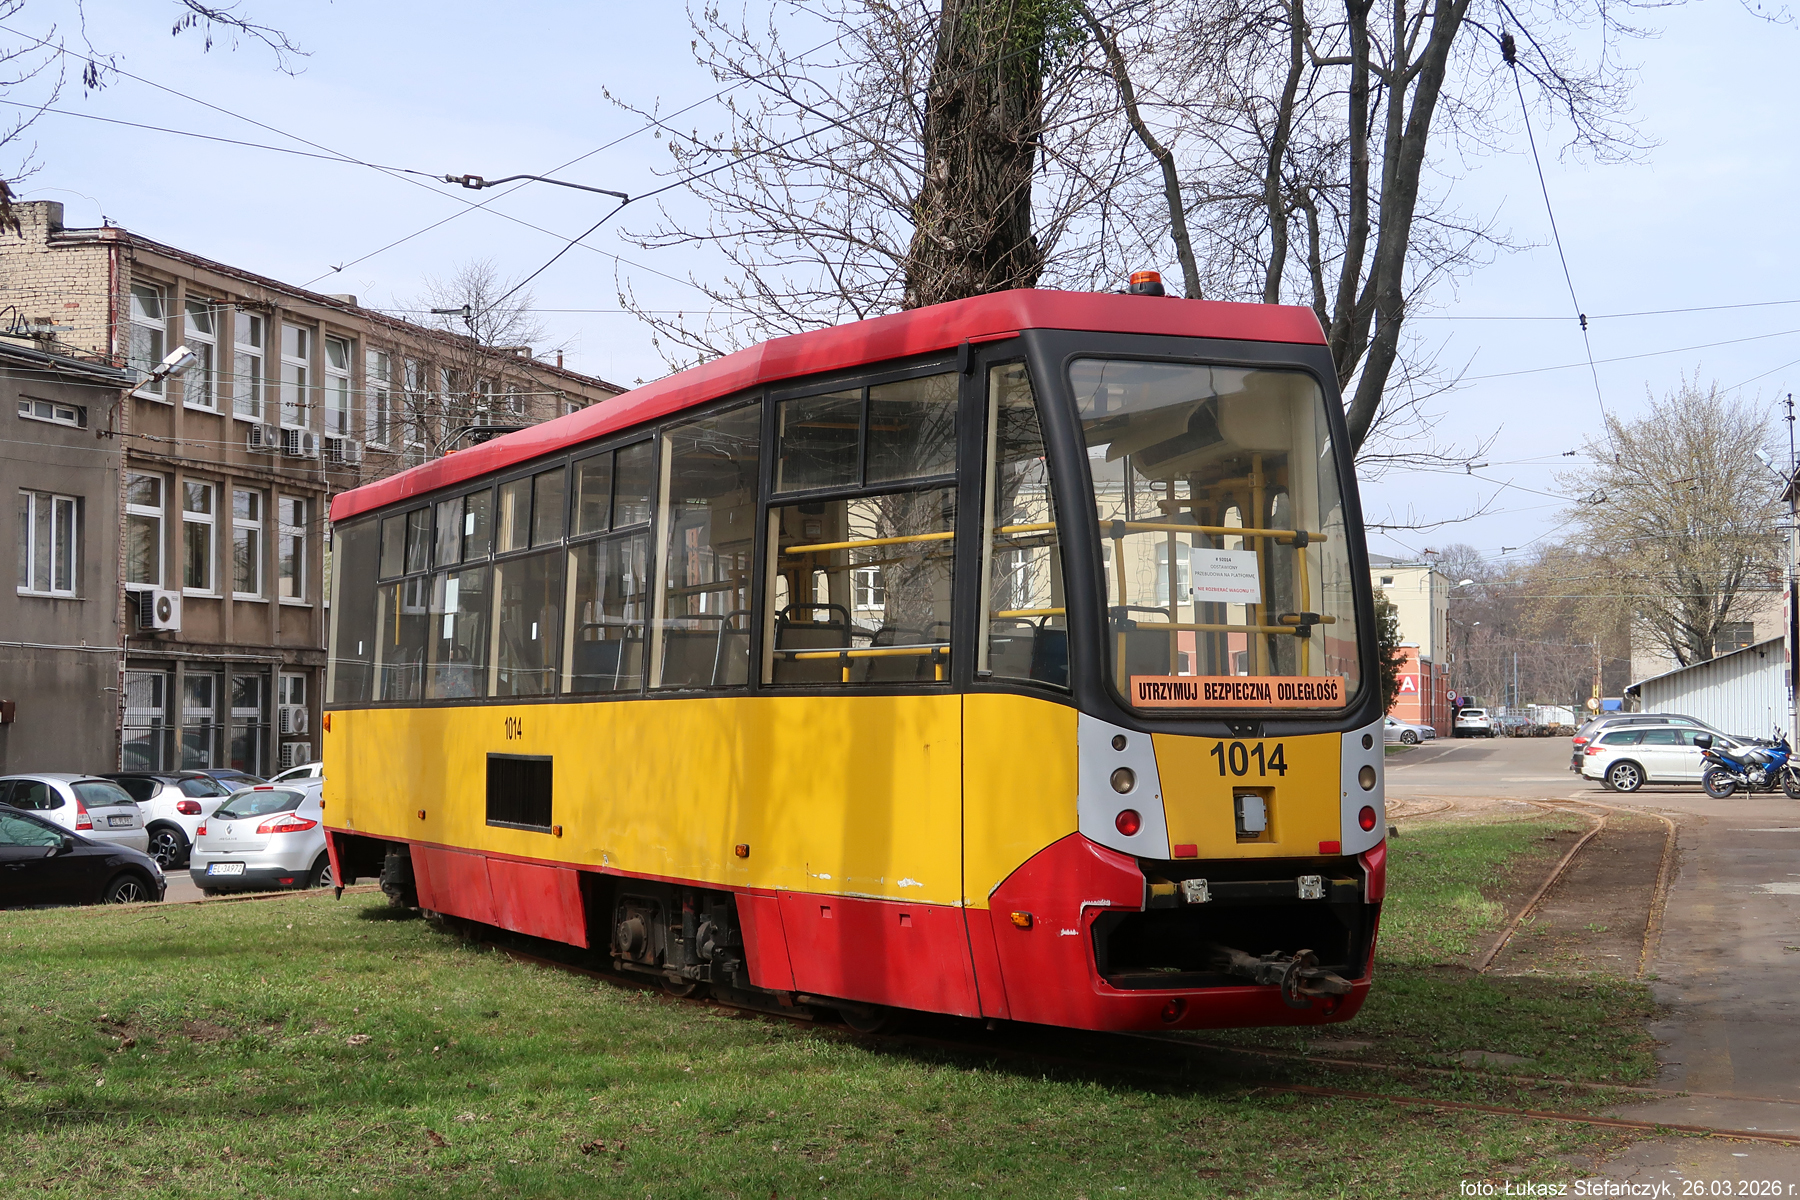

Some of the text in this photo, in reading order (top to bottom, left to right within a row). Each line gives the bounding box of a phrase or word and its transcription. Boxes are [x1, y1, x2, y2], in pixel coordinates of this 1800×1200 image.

[1138, 679, 1338, 704] UTRZYMUJ BEZPIECZNĄ ODLEGŁOŚĆ
[1400, 676, 1416, 691] A
[504, 716, 522, 740] 1014
[1210, 741, 1288, 776] 1014
[213, 864, 221, 873] EL
